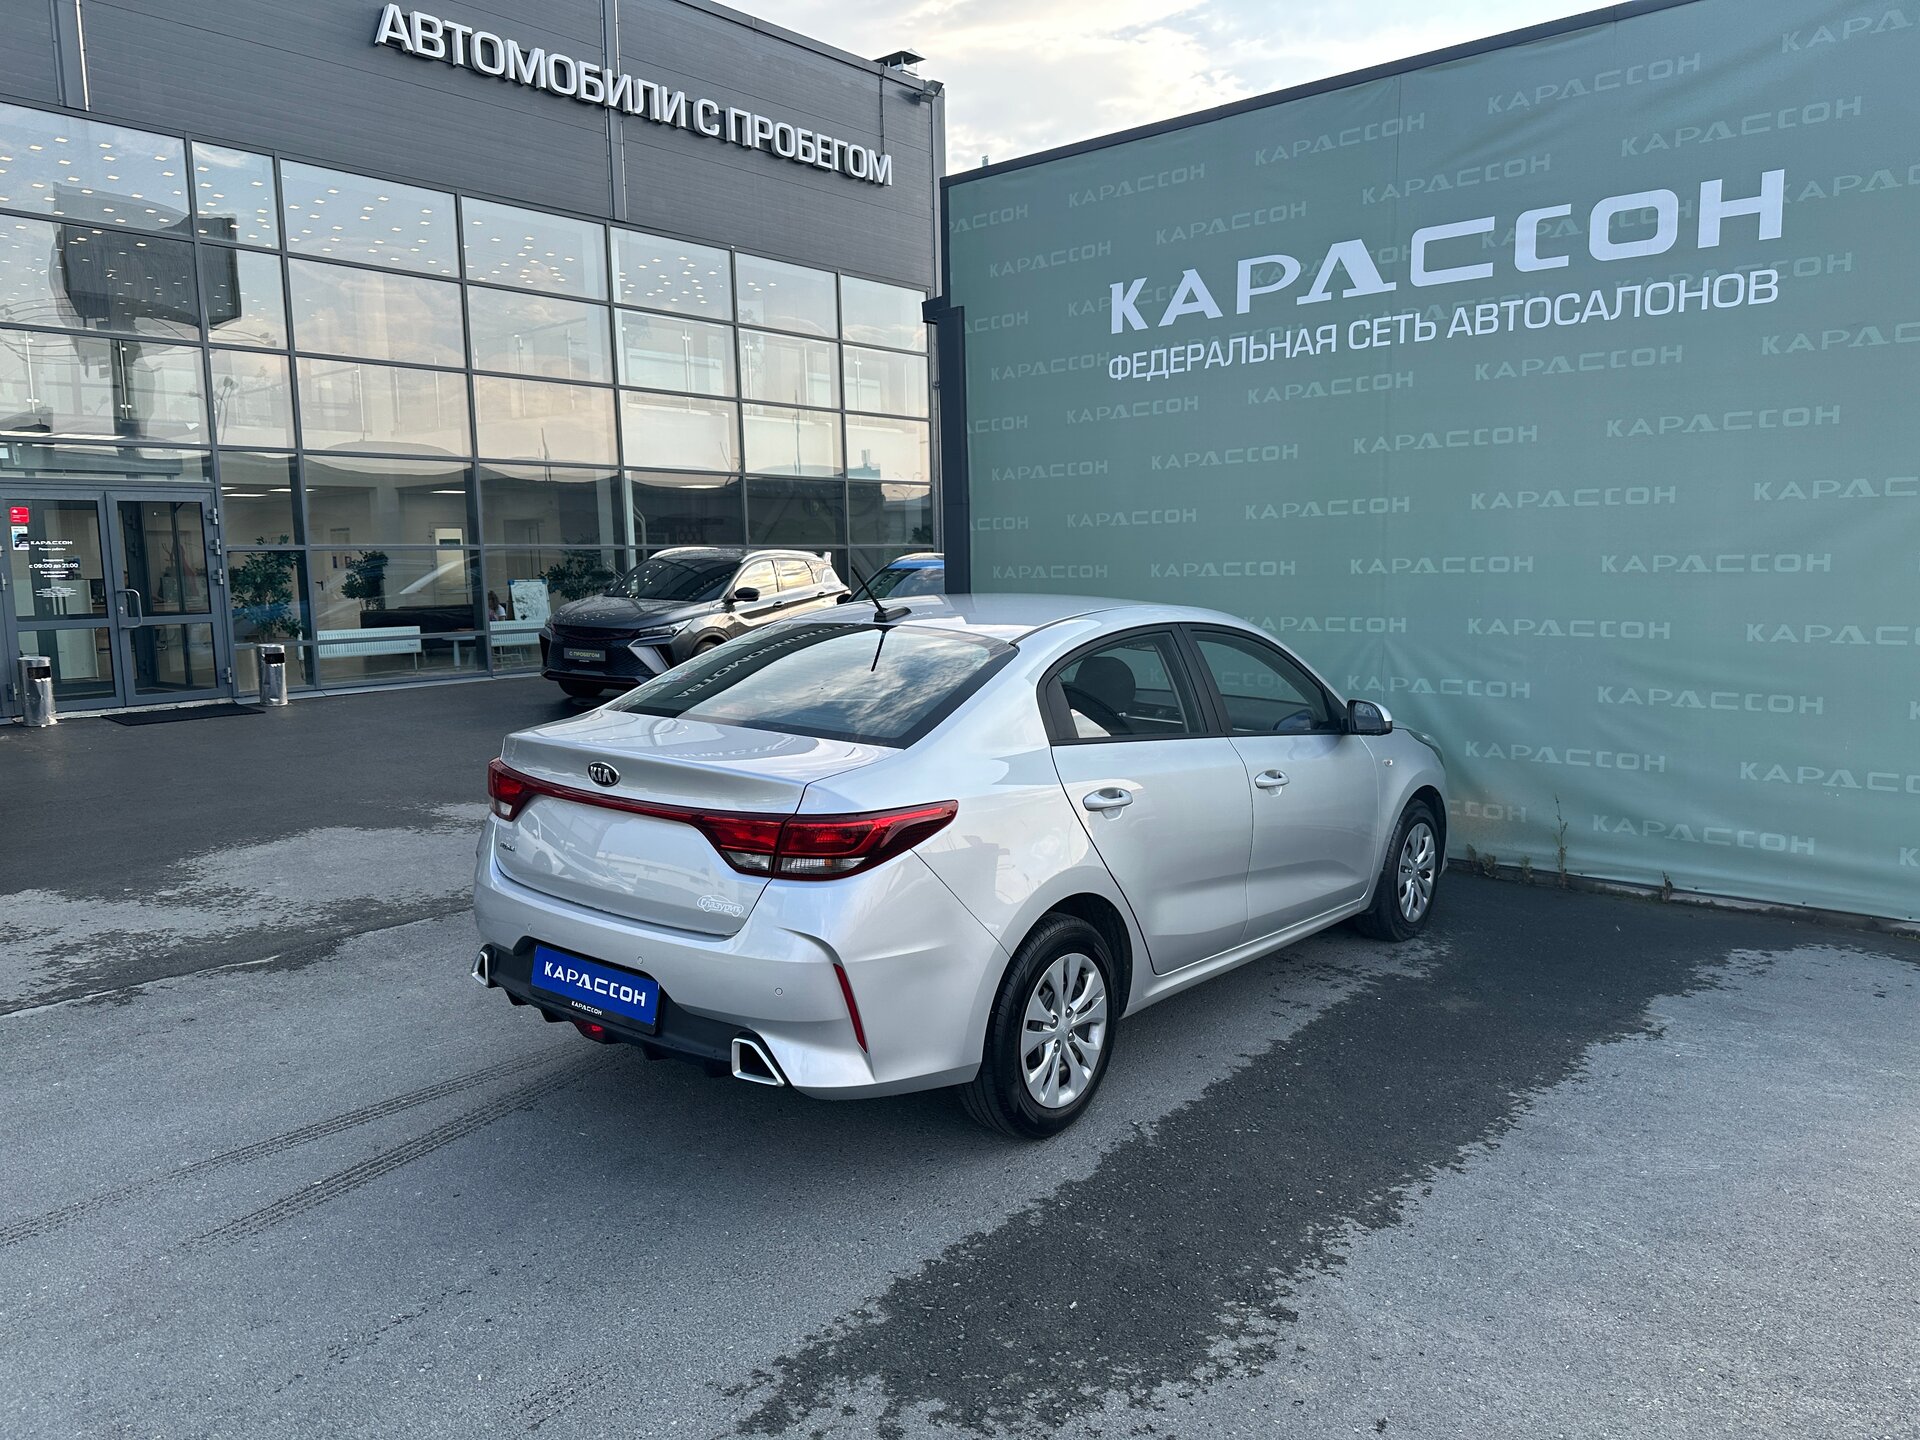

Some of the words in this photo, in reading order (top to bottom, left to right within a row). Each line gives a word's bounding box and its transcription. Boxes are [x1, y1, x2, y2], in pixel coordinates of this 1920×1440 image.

[1782, 8, 1920, 53] КАРА
[374, 3, 687, 128] АВТОМОБИЛИ
[693, 99, 720, 137] С
[725, 106, 893, 187] ПРОБЕГОМ
[1488, 53, 1701, 115] КАРАССОН
[1255, 114, 1425, 166] КАРАССОН
[1621, 96, 1862, 158] КАРАССОН
[1068, 163, 1205, 208] КАРАССОН
[1362, 153, 1551, 204] КАРАССОН
[948, 203, 1029, 233] АССОН
[1156, 200, 1306, 245] КАРАССОН
[989, 240, 1112, 279] КАРАССОН
[1109, 168, 1785, 335] КАРАССОН
[1108, 323, 1338, 382] ФЕДЕРАЛЬНАЯ
[1348, 312, 1437, 350] СЕТЬ
[1446, 268, 1780, 339] АВТОСАЛОНОВ
[991, 351, 1110, 381] КАРАССОН
[1475, 345, 1683, 381] КАРАССОН
[1247, 370, 1413, 404] КАРАССОН
[1066, 396, 1199, 424] КАРАССОН
[1606, 405, 1840, 438] КАРАССОН
[1353, 425, 1538, 454] КАРАССОН
[991, 460, 1108, 481] КАРАССОН
[1152, 444, 1298, 471] КАРАССОН
[1245, 497, 1410, 520] КАРАССОН
[1471, 487, 1676, 510] КАРАССОН
[1066, 508, 1197, 528] КАРАССОН
[992, 563, 1108, 579] КАРАССОН
[1150, 561, 1296, 578] КАРАССОН
[1350, 556, 1533, 574] КАРАССОН
[1602, 554, 1831, 573] КАРАССОН
[1468, 617, 1670, 639] КАРАССОН
[1347, 674, 1531, 699] КАРАССОН
[1598, 686, 1823, 715] КАРАССОН
[1466, 741, 1665, 773] КАРАССОН
[589, 765, 613, 782] KIA
[1593, 815, 1814, 855] КАРАССОН
[544, 960, 646, 1007] КАРАССОН
[571, 1001, 603, 1016] КАРАССОН
